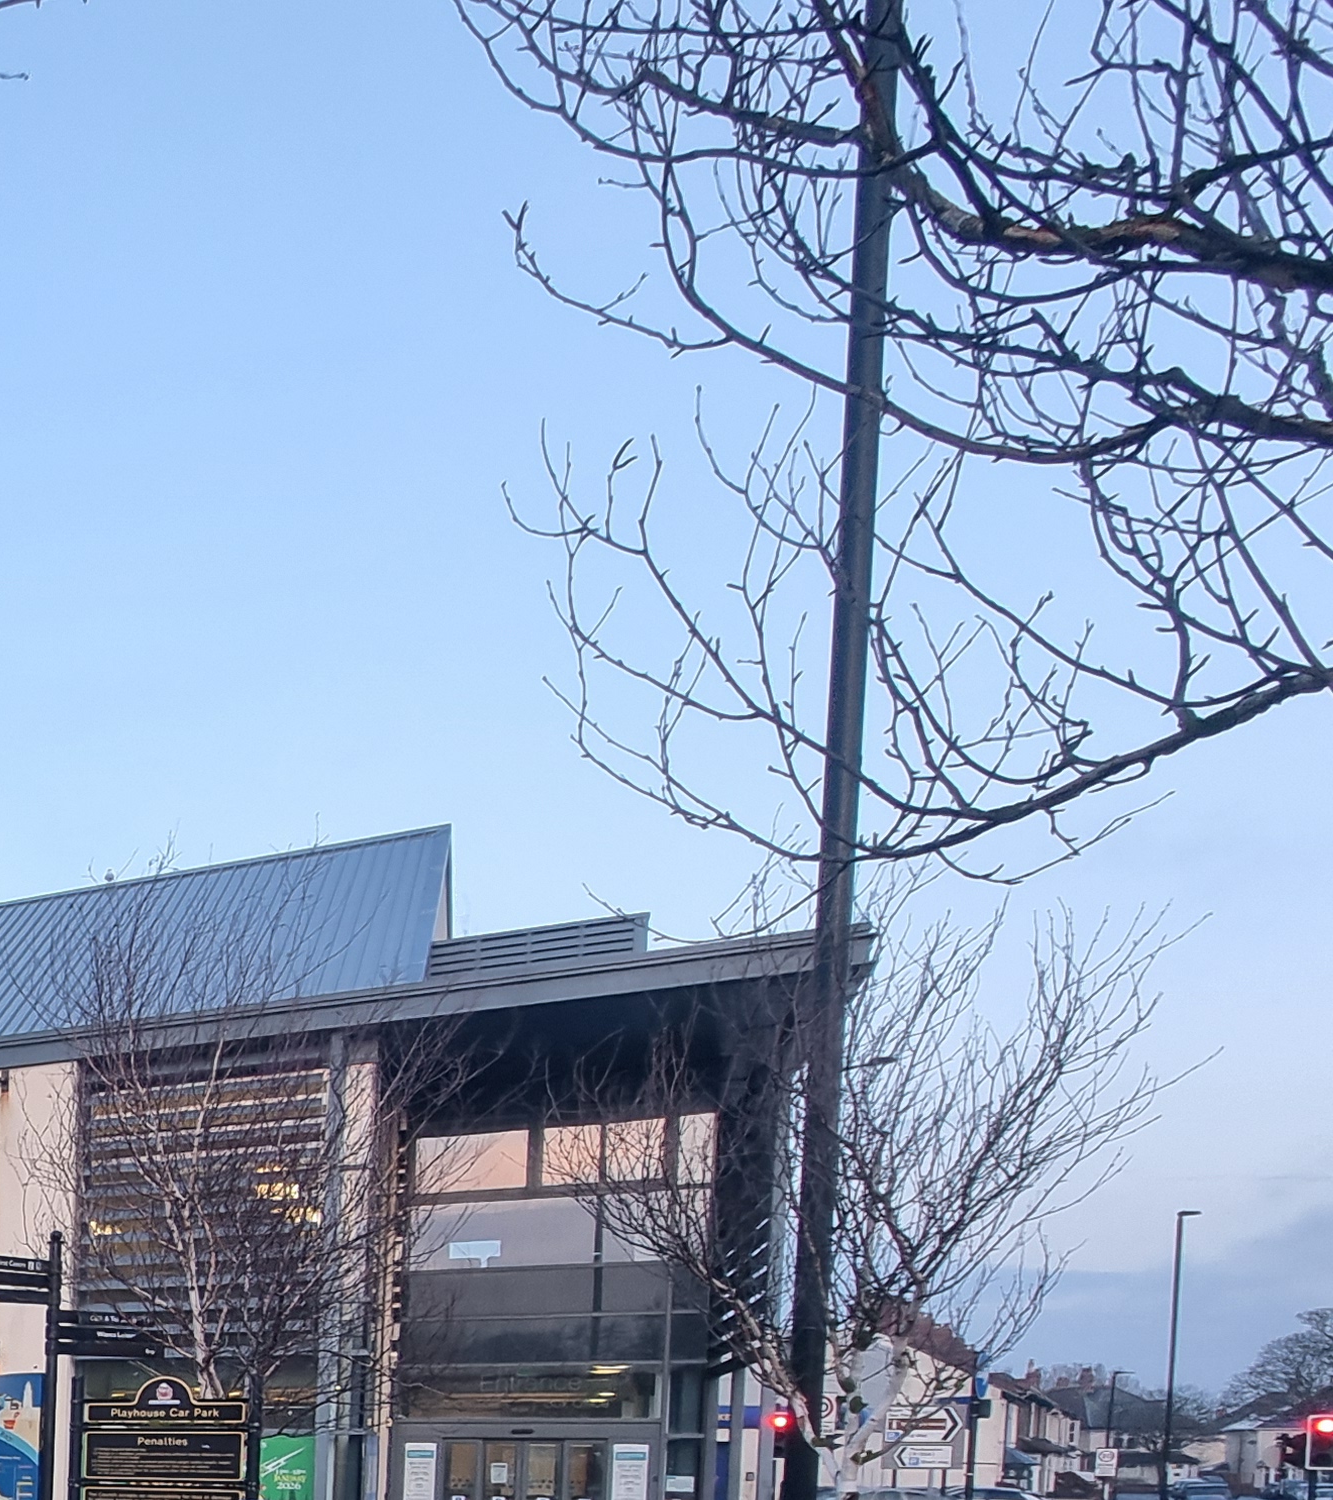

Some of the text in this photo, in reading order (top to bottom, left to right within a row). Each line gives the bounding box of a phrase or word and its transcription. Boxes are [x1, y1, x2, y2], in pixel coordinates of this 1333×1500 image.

[480, 1375, 582, 1393] Entrance
[111, 1408, 220, 1418] Playhouse Car Park
[137, 1437, 188, 1446] Penalties
